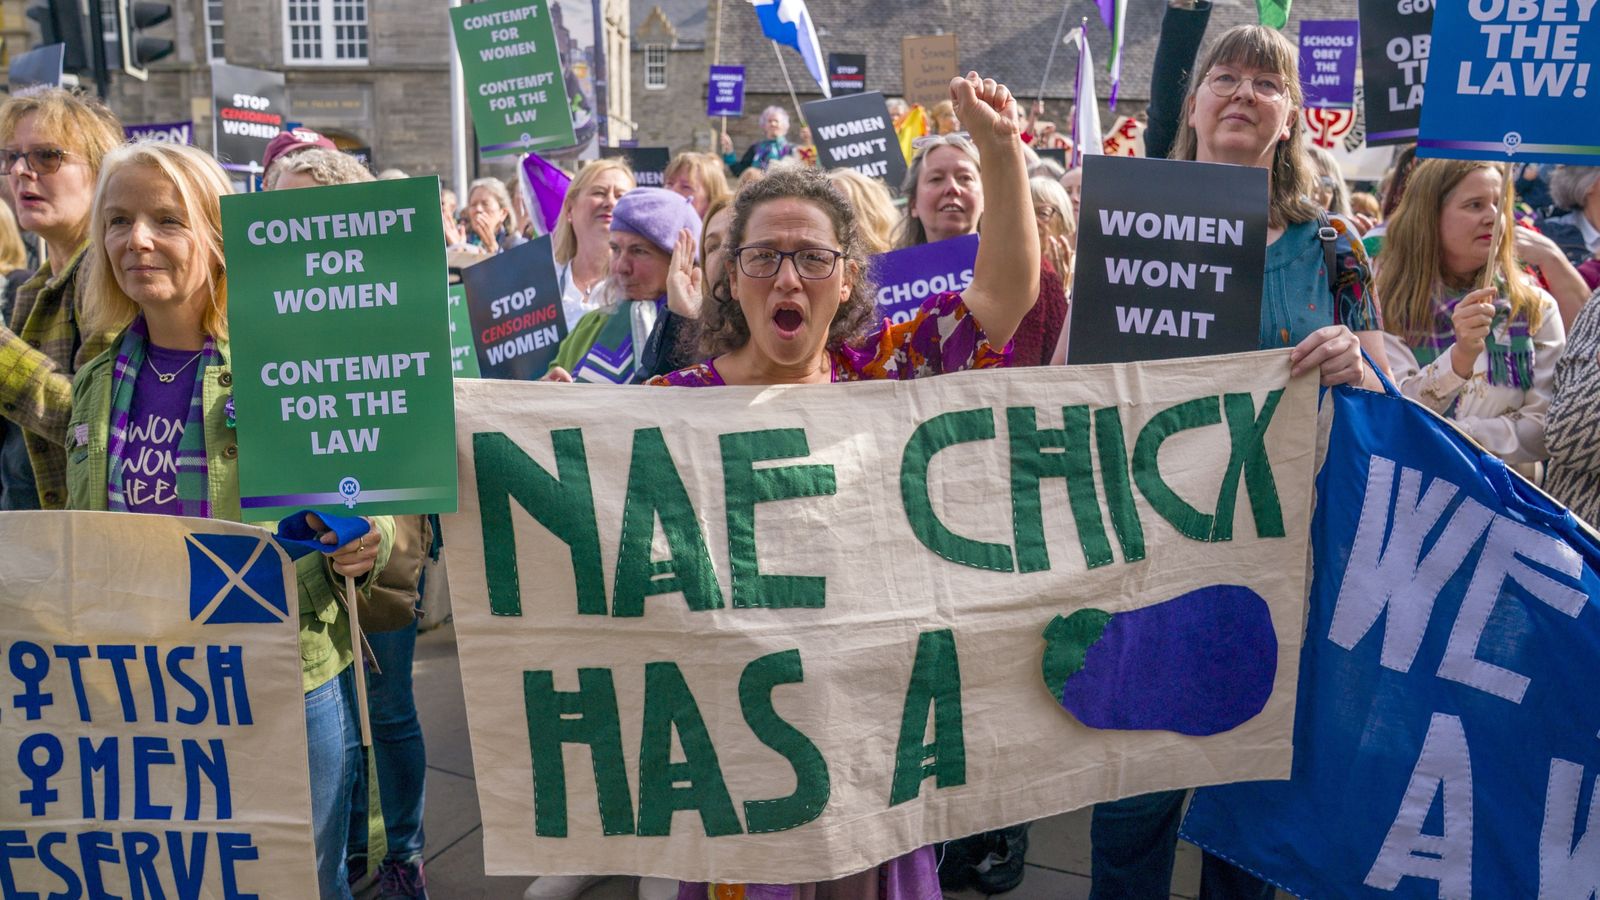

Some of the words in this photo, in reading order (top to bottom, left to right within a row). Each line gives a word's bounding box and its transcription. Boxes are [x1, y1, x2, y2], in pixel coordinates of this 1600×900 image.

[463, 5, 538, 30] CONTEMPT
[1468, 0, 1598, 22] OBEY
[490, 27, 519, 43] FOR
[1303, 35, 1354, 47] SCHOOLS
[1386, 34, 1432, 63] OB
[1480, 25, 1580, 60] THE
[480, 41, 536, 62] WOMEN
[1312, 48, 1342, 60] OBEY
[1315, 61, 1338, 72] THE
[479, 72, 554, 96] CONTEMPT
[1310, 73, 1341, 87] LAW!
[1457, 61, 1591, 98] LAW!
[233, 94, 270, 110] STOP
[489, 96, 517, 111] FOR
[519, 91, 548, 106] THE
[1389, 84, 1425, 112] LA
[223, 120, 280, 138] WOMEN
[505, 109, 537, 125] LAW
[818, 116, 885, 140] WOMEN
[829, 138, 886, 161] WON'T
[634, 171, 665, 185] MEN
[247, 207, 416, 246] CONTEMPT
[1099, 209, 1244, 246] WOMEN
[306, 249, 365, 277] FOR
[1105, 257, 1232, 293] WON'T
[273, 281, 398, 315] WOMEN
[875, 269, 974, 306] CHOOLS
[490, 287, 536, 319] STOP
[481, 304, 557, 344] CENSORING
[1115, 306, 1215, 339] WAIT
[486, 325, 559, 366] WOMEN
[260, 352, 430, 387] CONTEMPT
[280, 395, 338, 422] FOR
[346, 389, 408, 417] THE
[310, 427, 380, 455] LAW
[473, 427, 837, 617] NAE
[1327, 454, 1589, 704] WE
[0, 641, 253, 725] OTTISH
[523, 648, 831, 838] HAS
[889, 628, 966, 807] A
[18, 733, 232, 821] OMEN
[1363, 712, 1473, 900] A
[0, 830, 259, 900] ESERVE
